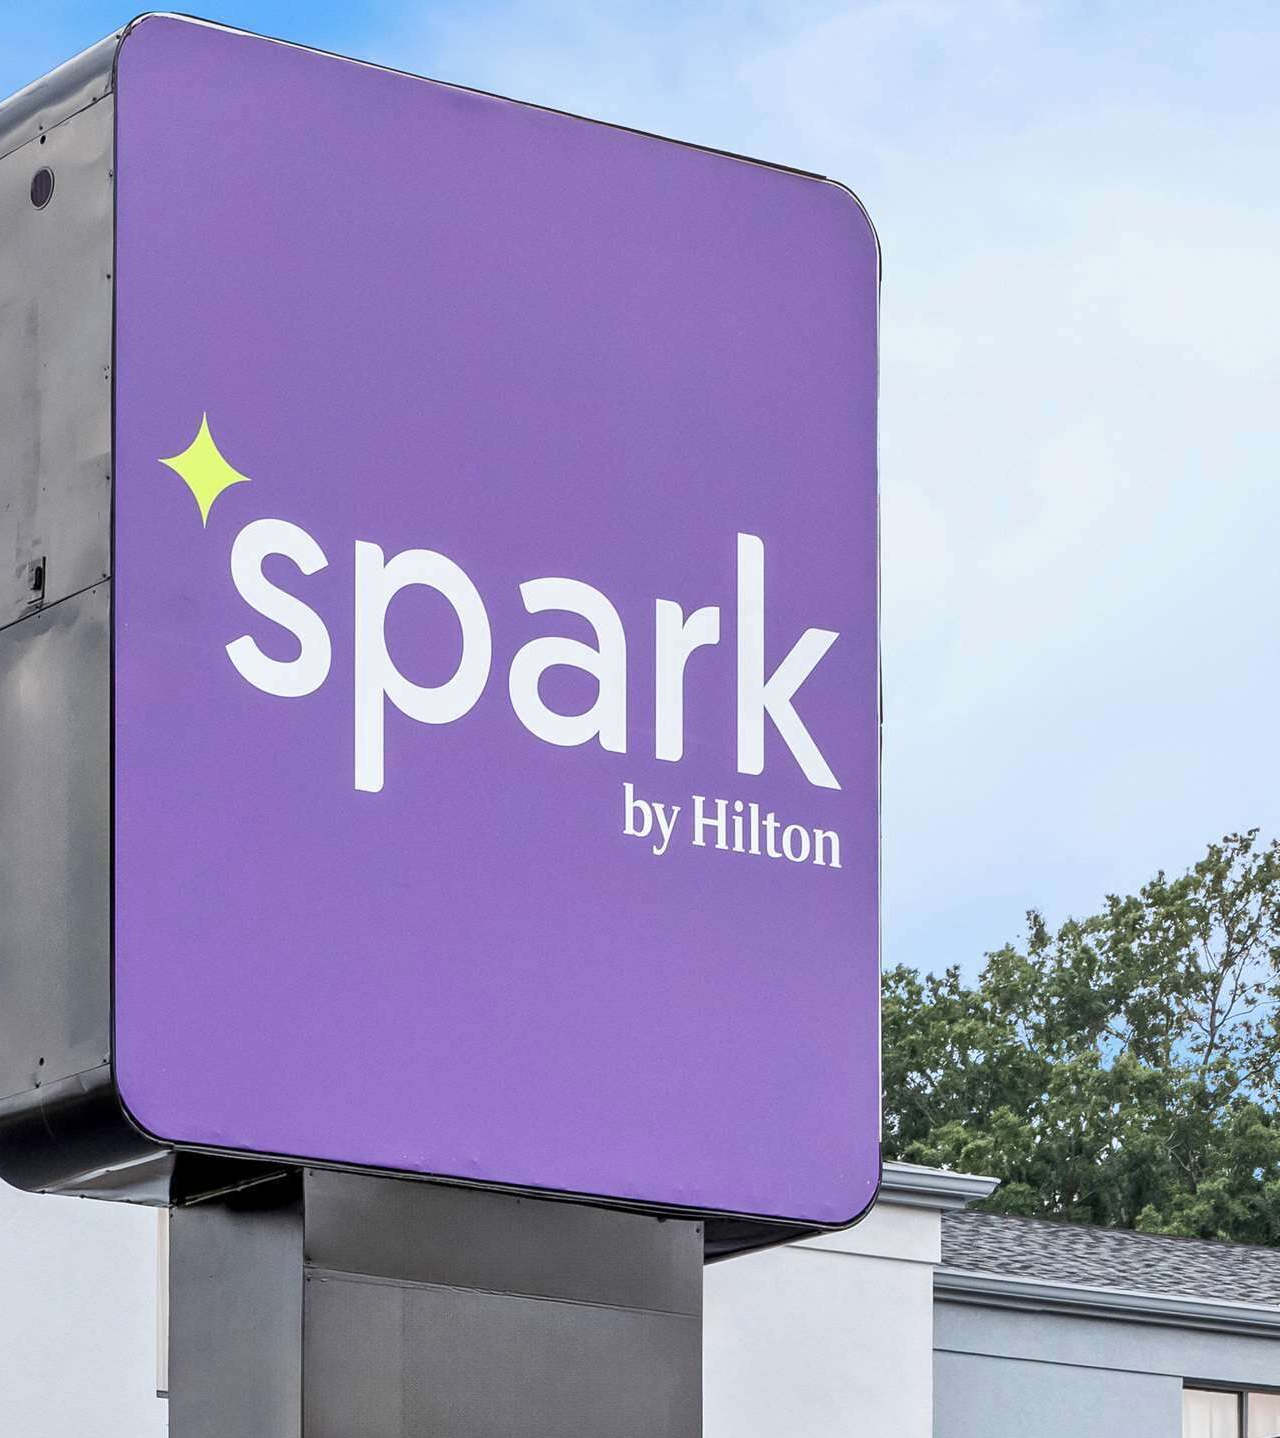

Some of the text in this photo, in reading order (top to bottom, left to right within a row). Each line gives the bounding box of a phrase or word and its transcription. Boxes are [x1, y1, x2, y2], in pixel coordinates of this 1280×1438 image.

[225, 518, 842, 793] spark
[623, 782, 842, 868] by Hilton
